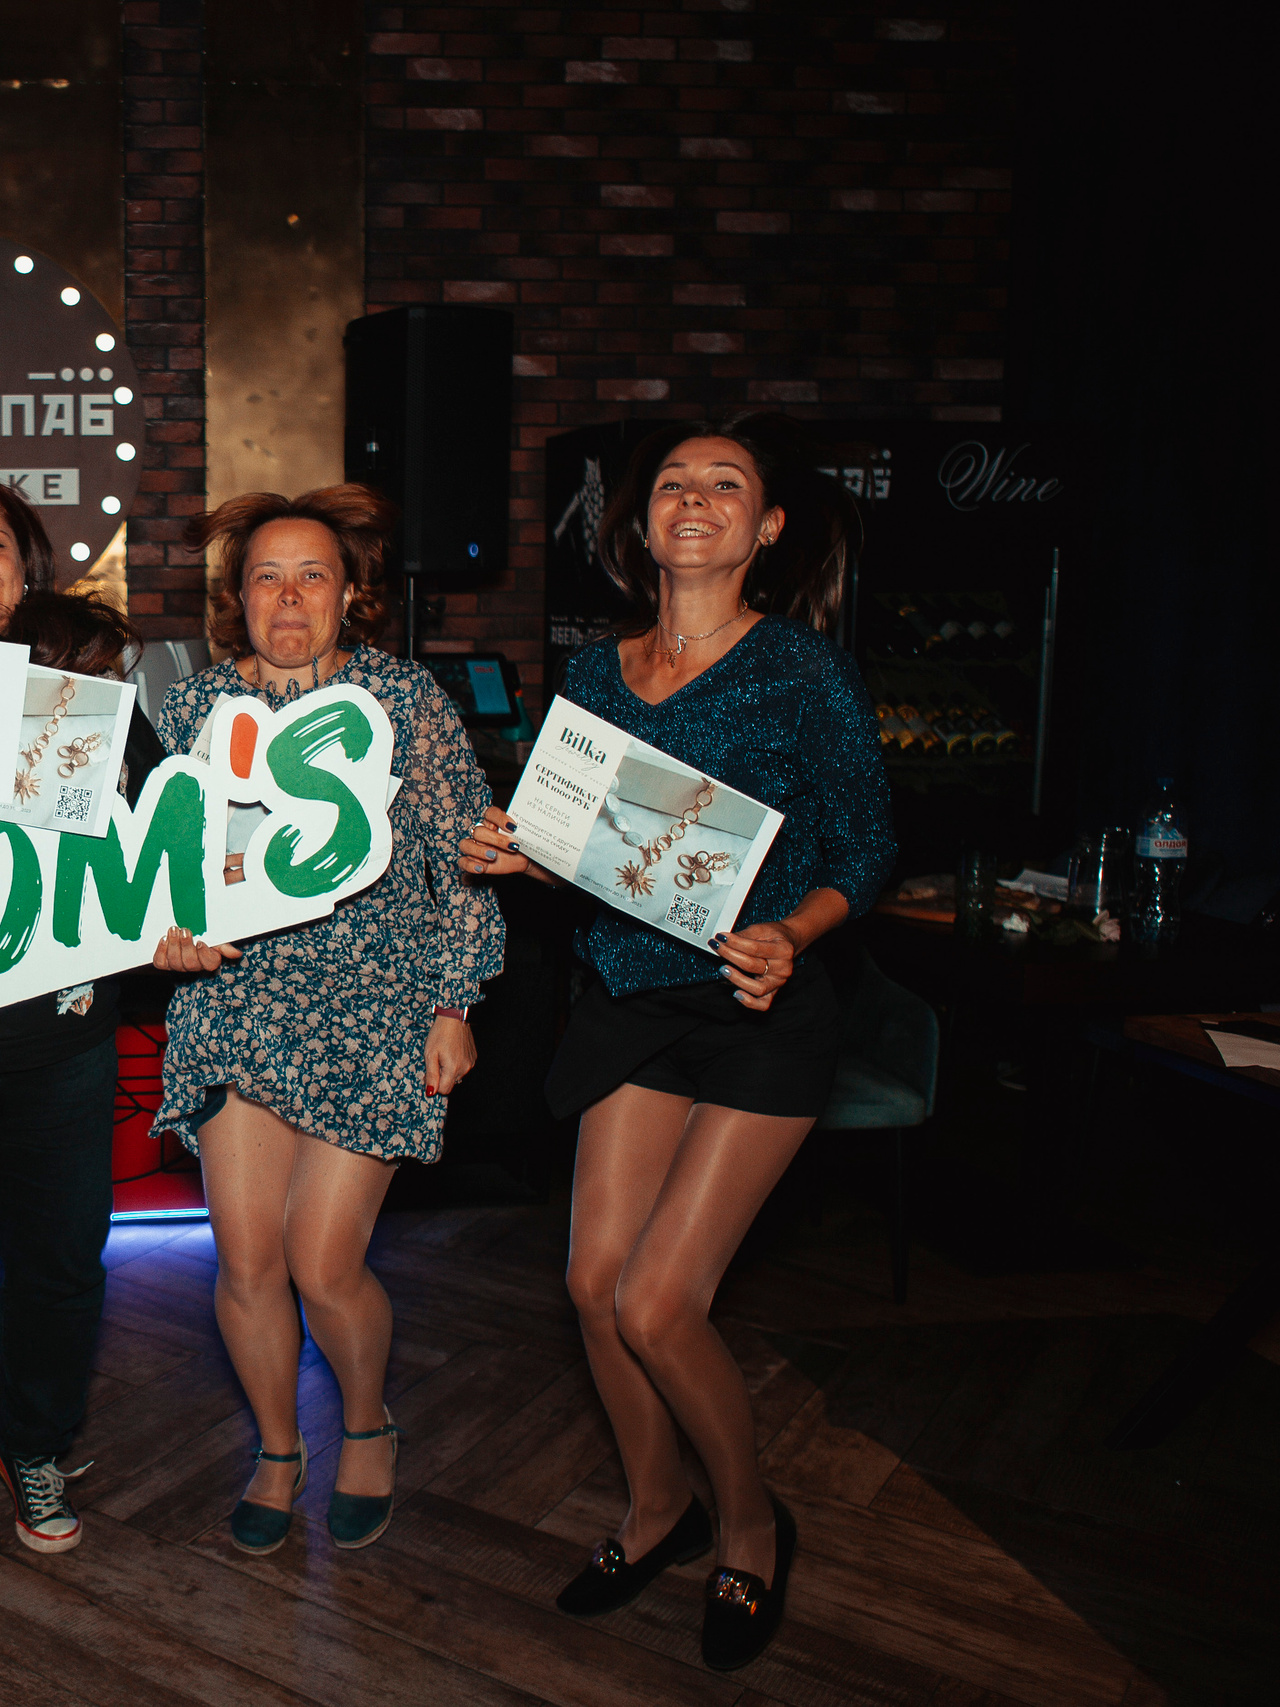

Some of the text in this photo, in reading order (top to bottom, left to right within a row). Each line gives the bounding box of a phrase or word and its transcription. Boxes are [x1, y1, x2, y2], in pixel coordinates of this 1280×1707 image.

[937, 439, 1064, 511] Wine
[559, 727, 607, 764] Bilka
[535, 764, 598, 803] СЕРТИФИКАТ
[537, 775, 590, 810] НА 1000 РУБ
[526, 800, 570, 828] ИЗ НАЛИЧИЯ
[534, 797, 570, 820] НА СЕРЬГИ
